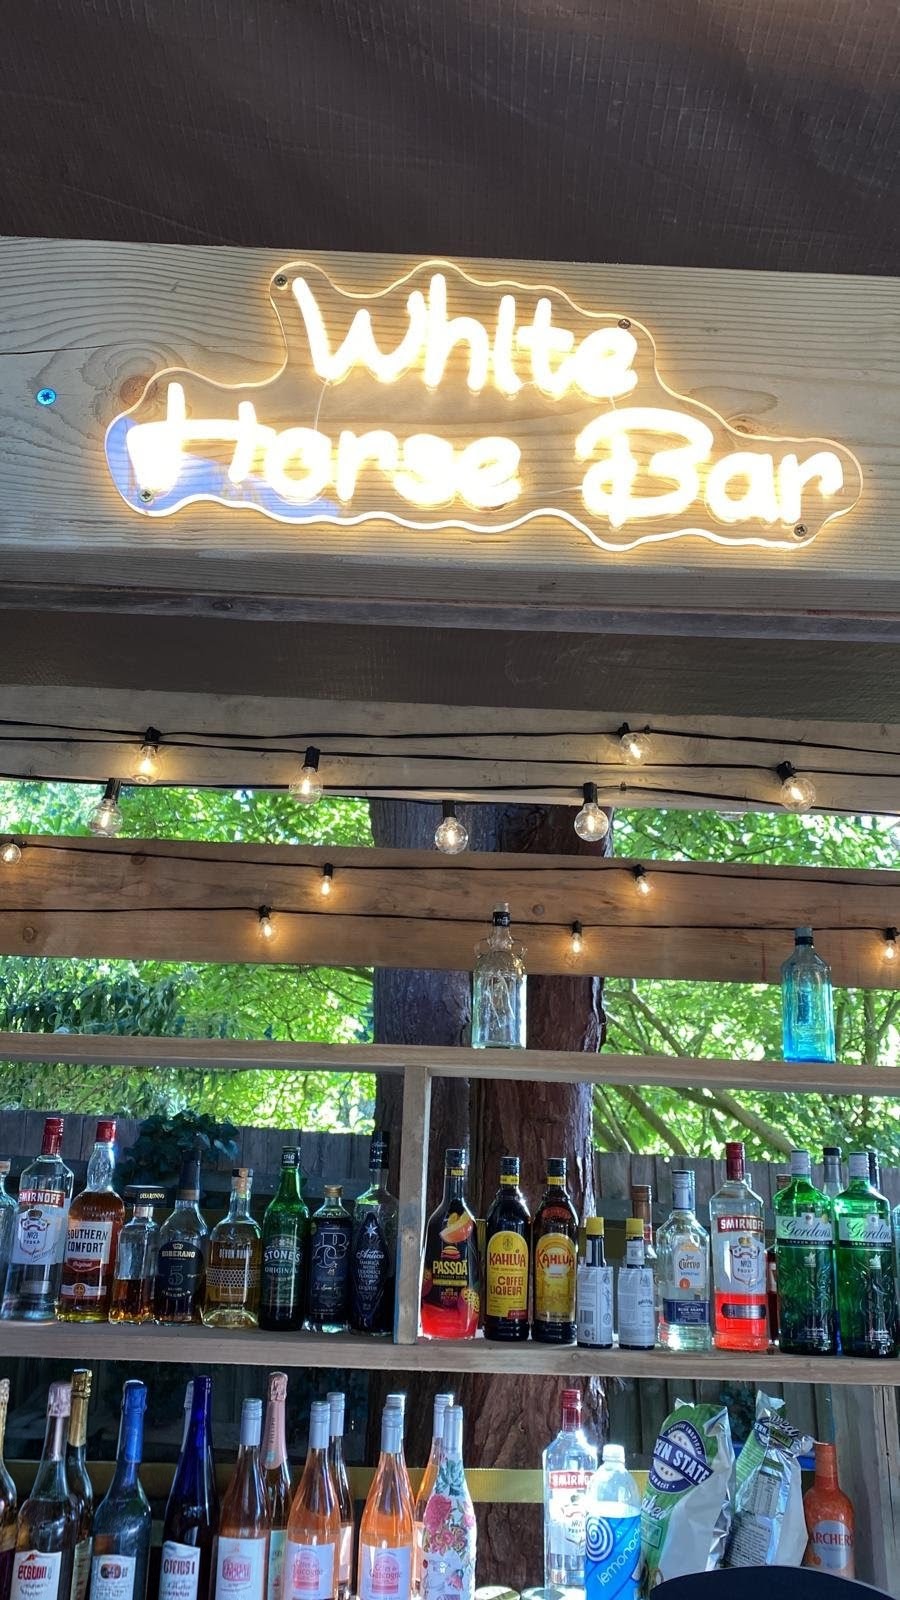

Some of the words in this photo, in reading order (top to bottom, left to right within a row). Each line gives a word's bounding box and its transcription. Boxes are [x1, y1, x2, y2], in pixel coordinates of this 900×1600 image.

[290, 272, 638, 400] White
[124, 382, 523, 510] Horse
[574, 406, 845, 529] Bar
[67, 1228, 108, 1241] SOUTHERN
[720, 1218, 764, 1231] SMIRNOFF
[67, 1241, 104, 1253] COMFORT
[597, 1527, 640, 1587] lemonad
